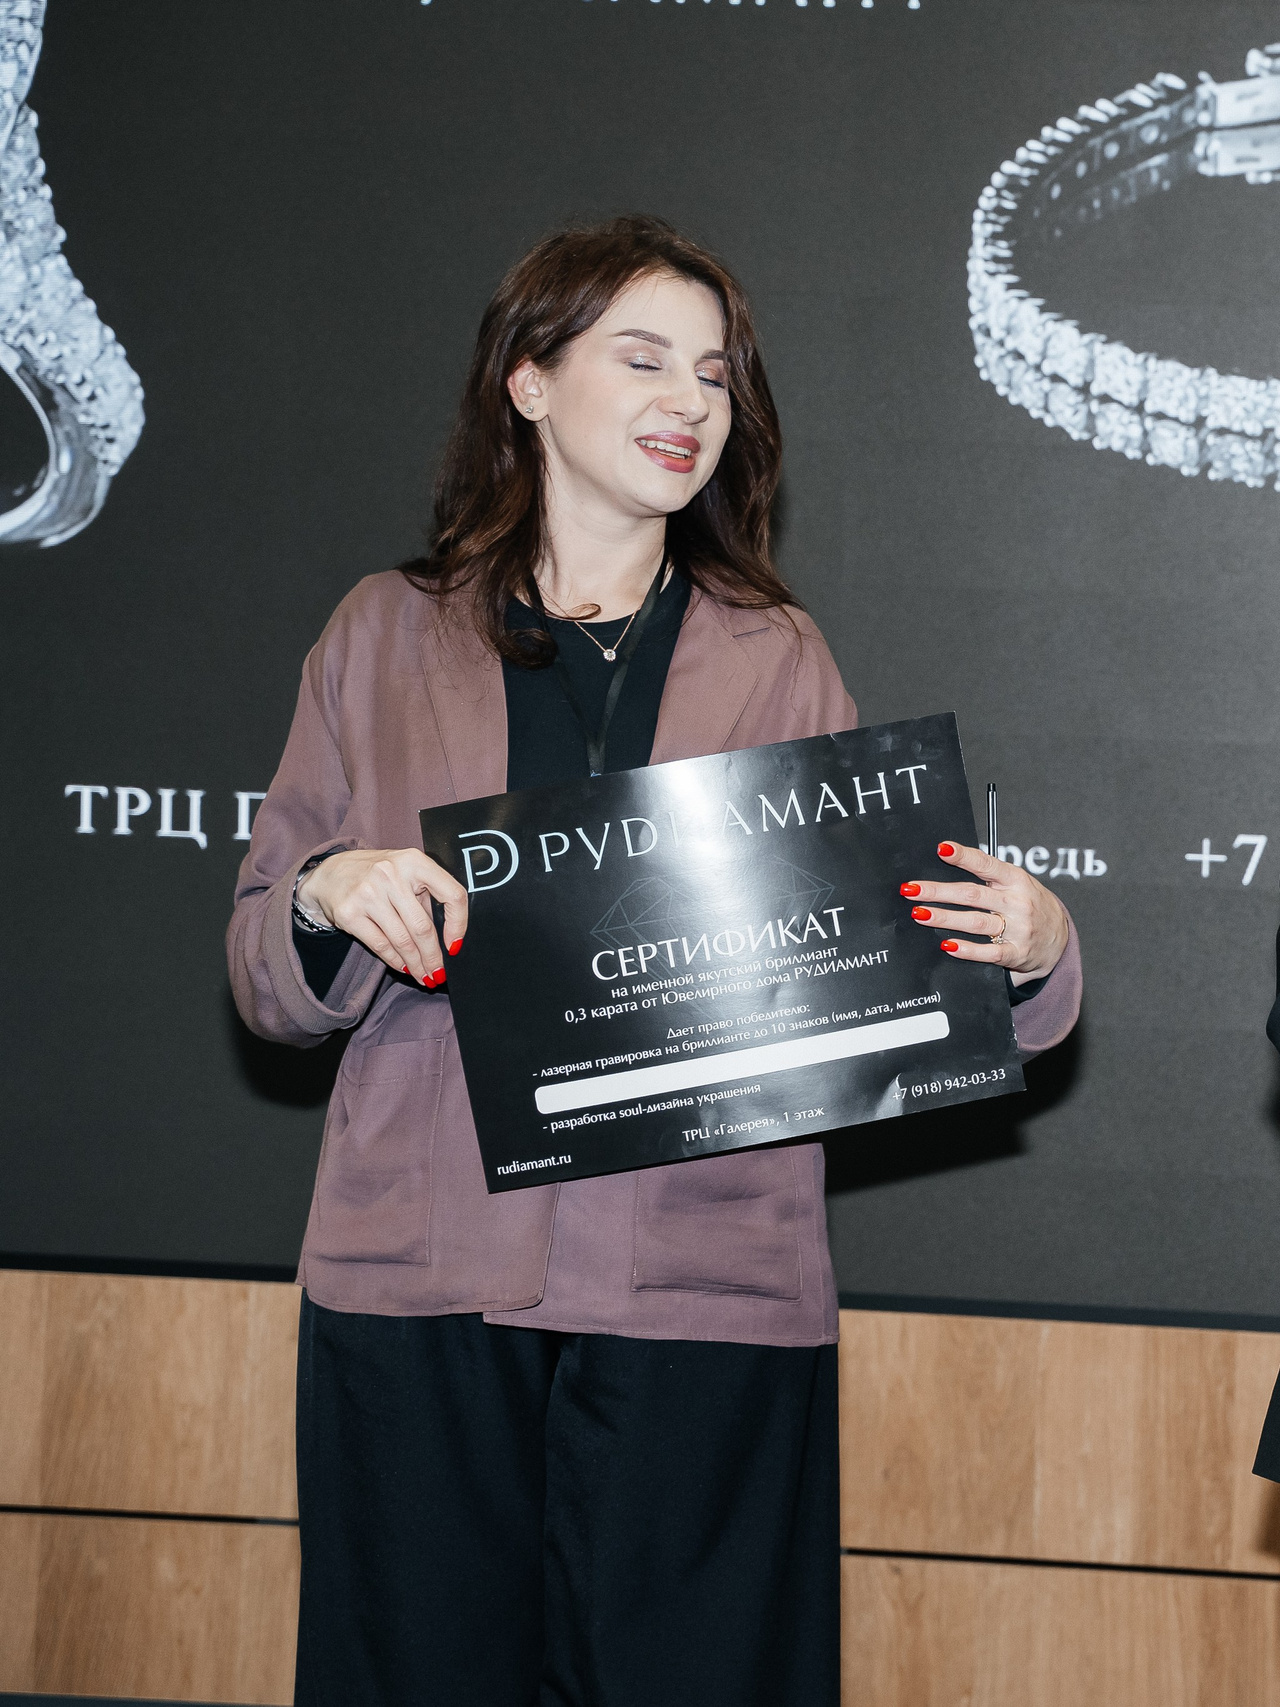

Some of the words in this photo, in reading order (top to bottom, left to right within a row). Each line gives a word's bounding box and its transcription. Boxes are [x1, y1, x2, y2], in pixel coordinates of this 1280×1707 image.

[64, 784, 208, 850] ТРЦ
[979, 842, 1108, 881] редь
[1184, 833, 1268, 886] +7
[591, 906, 845, 981] СЕРТИФИКАТ
[564, 1008, 587, 1024] 0,3
[591, 1002, 638, 1019] карата
[641, 997, 658, 1009] от
[661, 980, 752, 1005] Ювелирного
[756, 972, 791, 988] дома
[794, 950, 889, 980] РУДИАМАНТ
[611, 987, 628, 999] на
[632, 973, 694, 995] именной
[699, 961, 762, 984] якутский
[765, 947, 838, 971] бриллиант
[540, 1061, 592, 1078] лазерная
[595, 1048, 662, 1070] гравировка
[665, 1045, 680, 1055] на
[682, 1031, 751, 1052] бриллианте
[753, 1029, 768, 1039] до
[771, 1023, 786, 1034] 10
[789, 1017, 830, 1031] знаков
[831, 1010, 862, 1025] (имя,
[864, 1003, 894, 1017] дата,
[896, 991, 941, 1010] миссия)
[666, 1026, 695, 1039] Дает
[698, 1019, 733, 1035] право
[736, 1003, 811, 1026] победителю:
[550, 1111, 617, 1133] разработка
[619, 1096, 694, 1118] soul-дизайна
[696, 1084, 761, 1106] украшения
[892, 1088, 907, 1101] +7
[911, 1080, 942, 1099] (918)
[945, 1068, 1006, 1091] 942-03-33
[682, 1127, 711, 1142] ТРЦ
[714, 1116, 780, 1137] «Галерея»,
[783, 1112, 790, 1123] 1
[793, 1106, 825, 1120] этаж
[497, 1154, 572, 1176] rudiamant.ru
